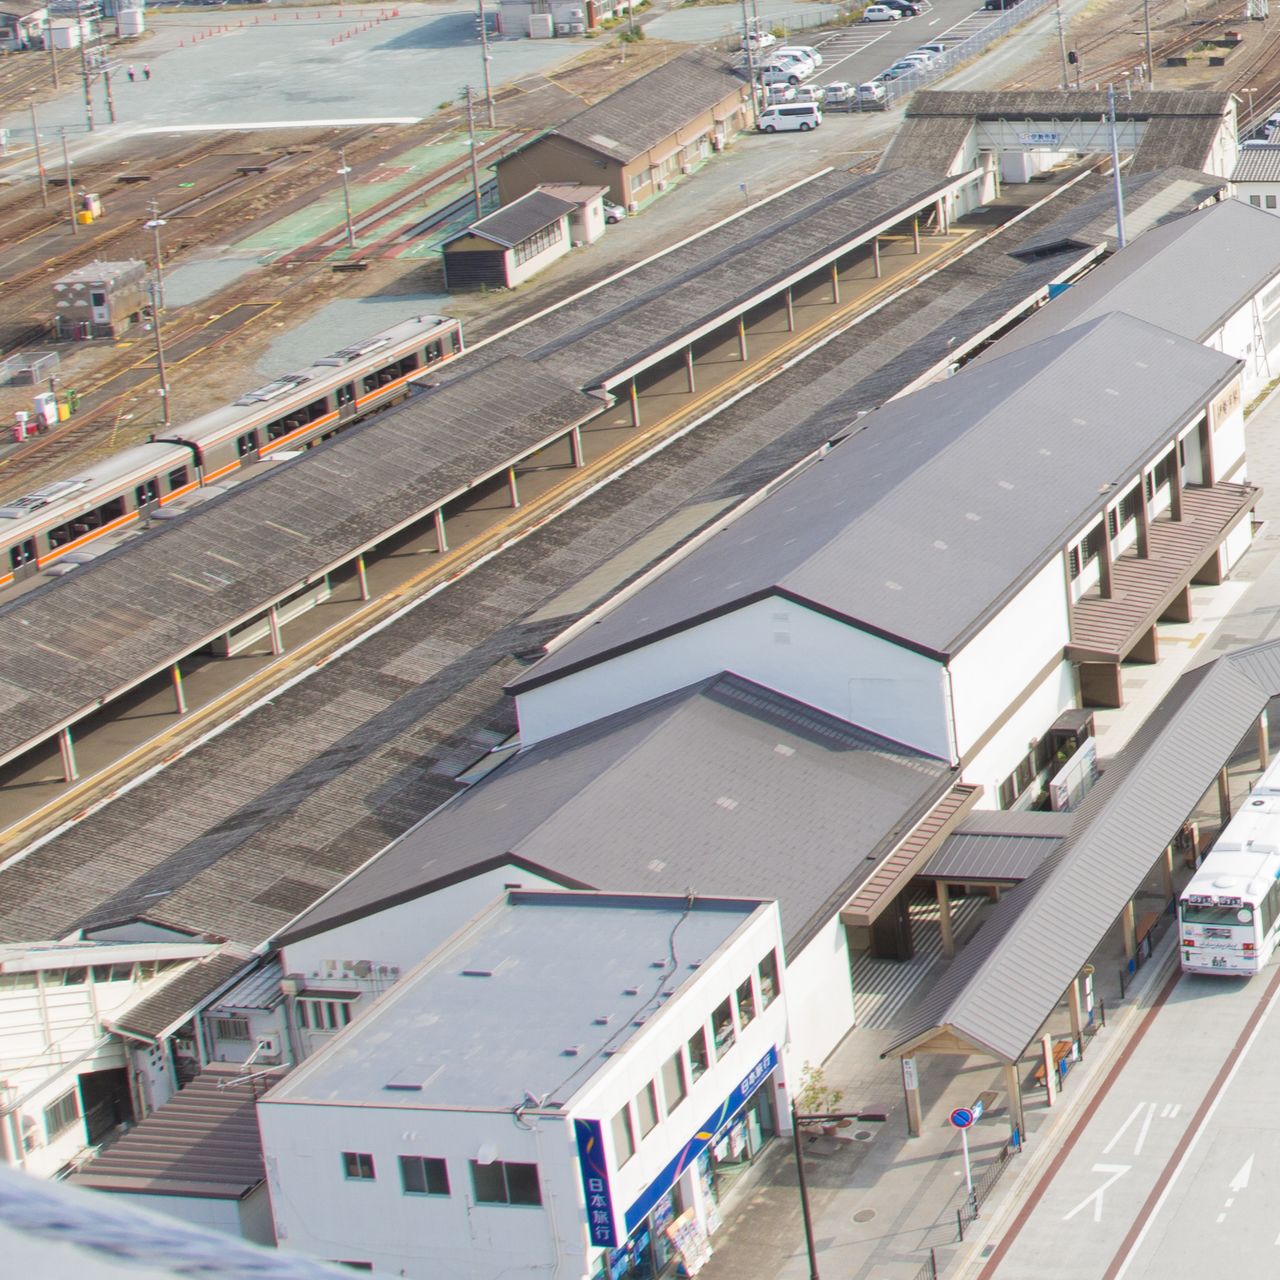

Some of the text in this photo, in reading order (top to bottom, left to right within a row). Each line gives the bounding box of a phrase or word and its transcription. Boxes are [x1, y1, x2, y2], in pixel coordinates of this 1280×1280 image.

[740, 1053, 773, 1096] 日本旅行
[1063, 1102, 1183, 1222] バス
[588, 1178, 611, 1241] 日本旅行
